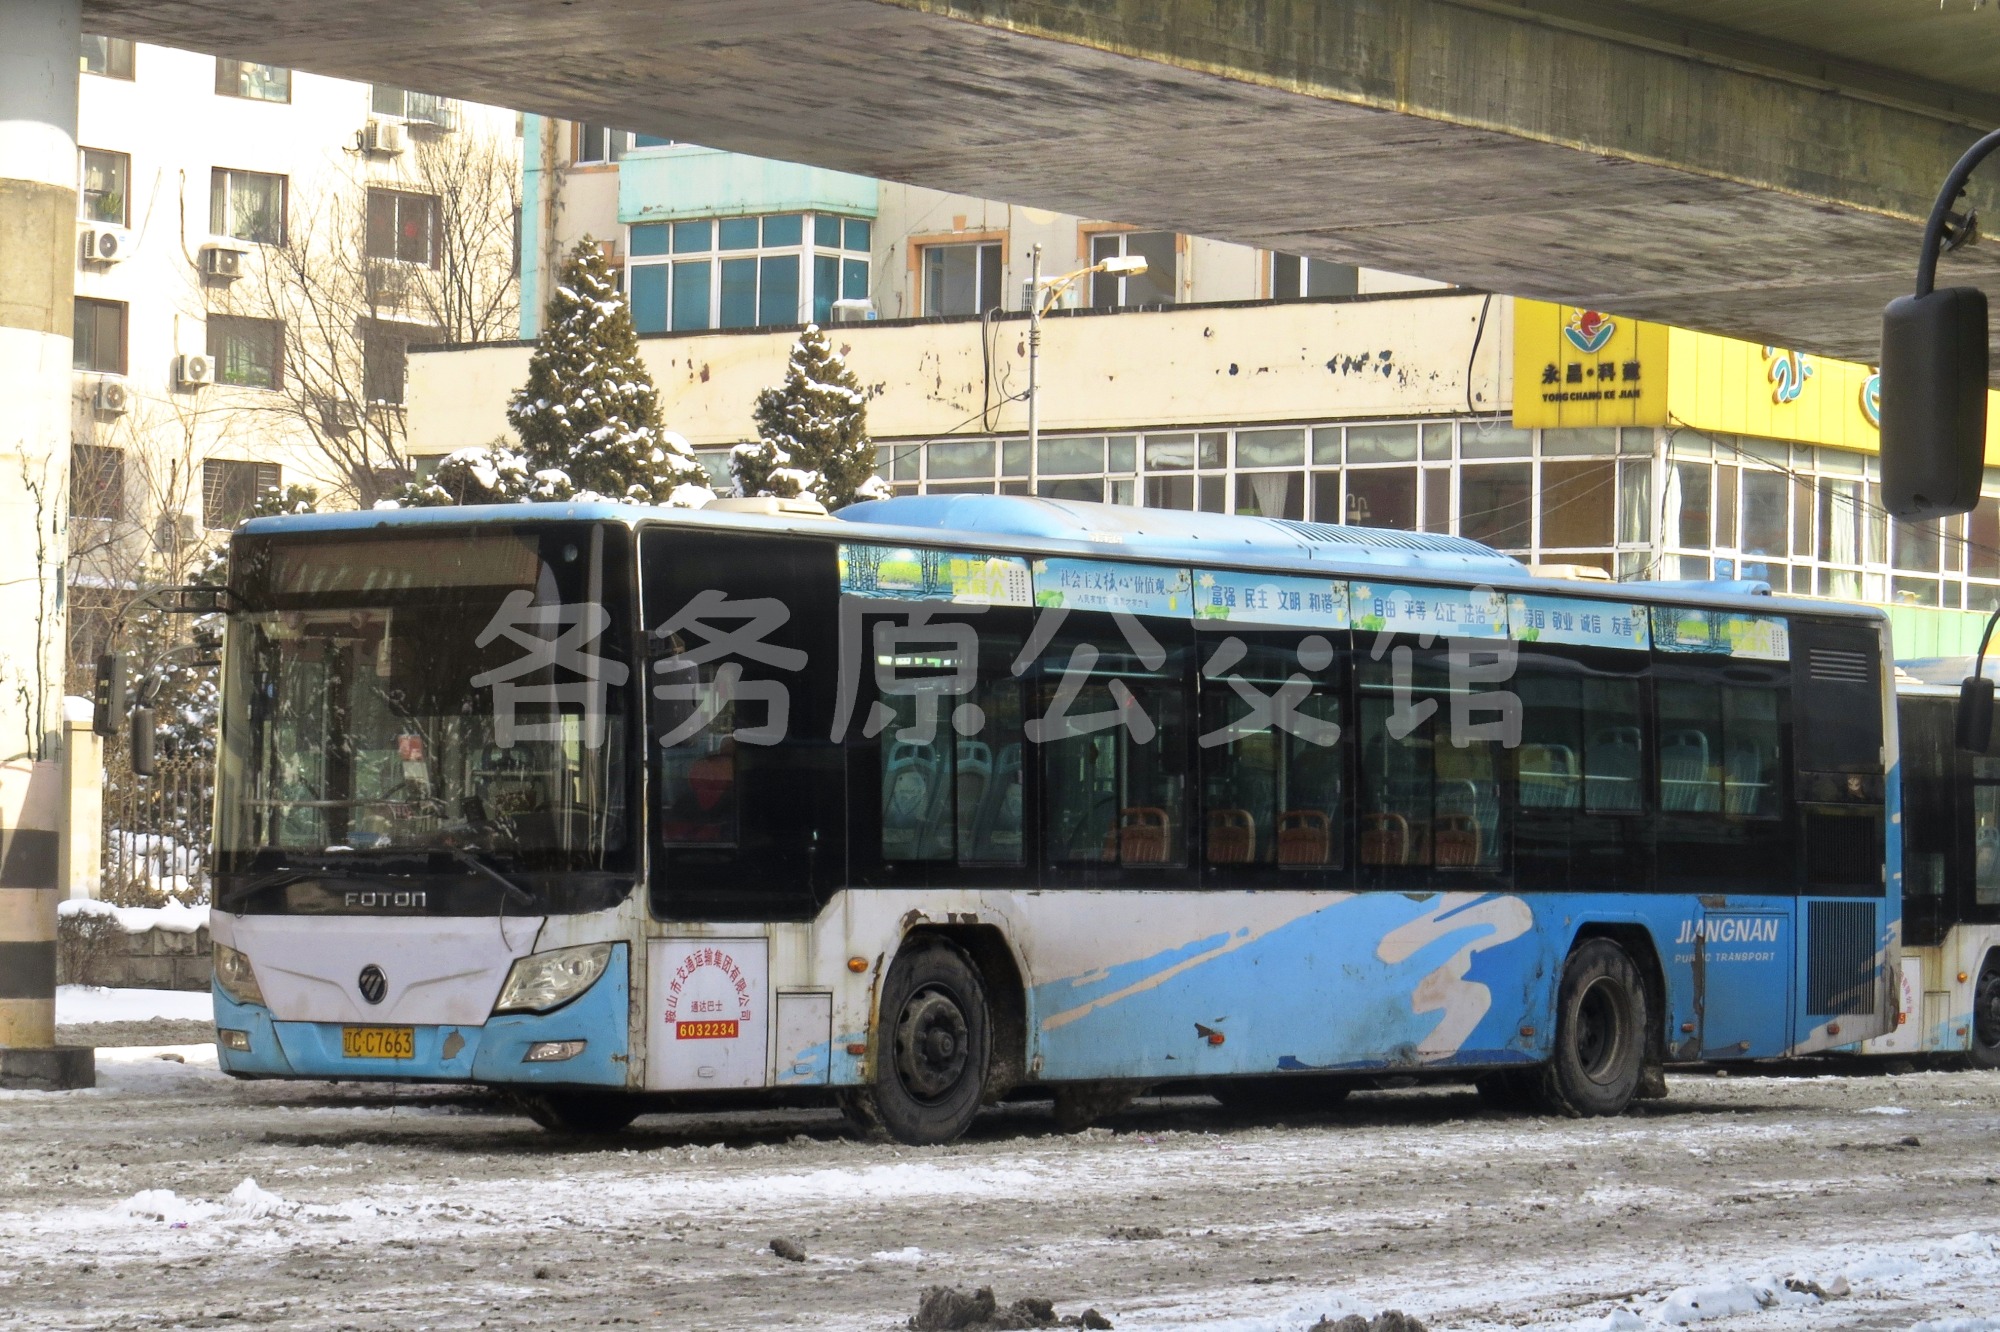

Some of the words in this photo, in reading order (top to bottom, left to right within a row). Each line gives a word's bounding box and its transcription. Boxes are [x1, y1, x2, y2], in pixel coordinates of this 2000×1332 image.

[1543, 393, 1568, 402] YONG
[1570, 391, 1601, 401] CHANG
[1604, 391, 1615, 400] KE
[1619, 389, 1640, 399] JIAN
[1060, 567, 1167, 595] 社会主义核心价值观
[1211, 585, 1236, 607] 富强
[1245, 588, 1269, 609] 民主
[1277, 590, 1301, 612] 文明
[1309, 592, 1333, 614] 和谐
[1374, 597, 1396, 618] 自由
[1404, 599, 1427, 620] 平等
[1434, 602, 1457, 622] 公正
[1463, 603, 1486, 624] 法治
[1524, 609, 1545, 629] 爱国
[1552, 611, 1573, 631] 敬业
[1580, 612, 1601, 634] 诚信
[1611, 615, 1632, 637] 友善
[345, 892, 426, 907] FOTON
[1675, 918, 1779, 944] JIANGNAN
[1716, 951, 1775, 962] TRANSPORT
[664, 947, 751, 1024] 鞍山市交通运输集团有限公司
[691, 1000, 723, 1013] 通达巴士
[679, 1023, 735, 1037] 6032234
